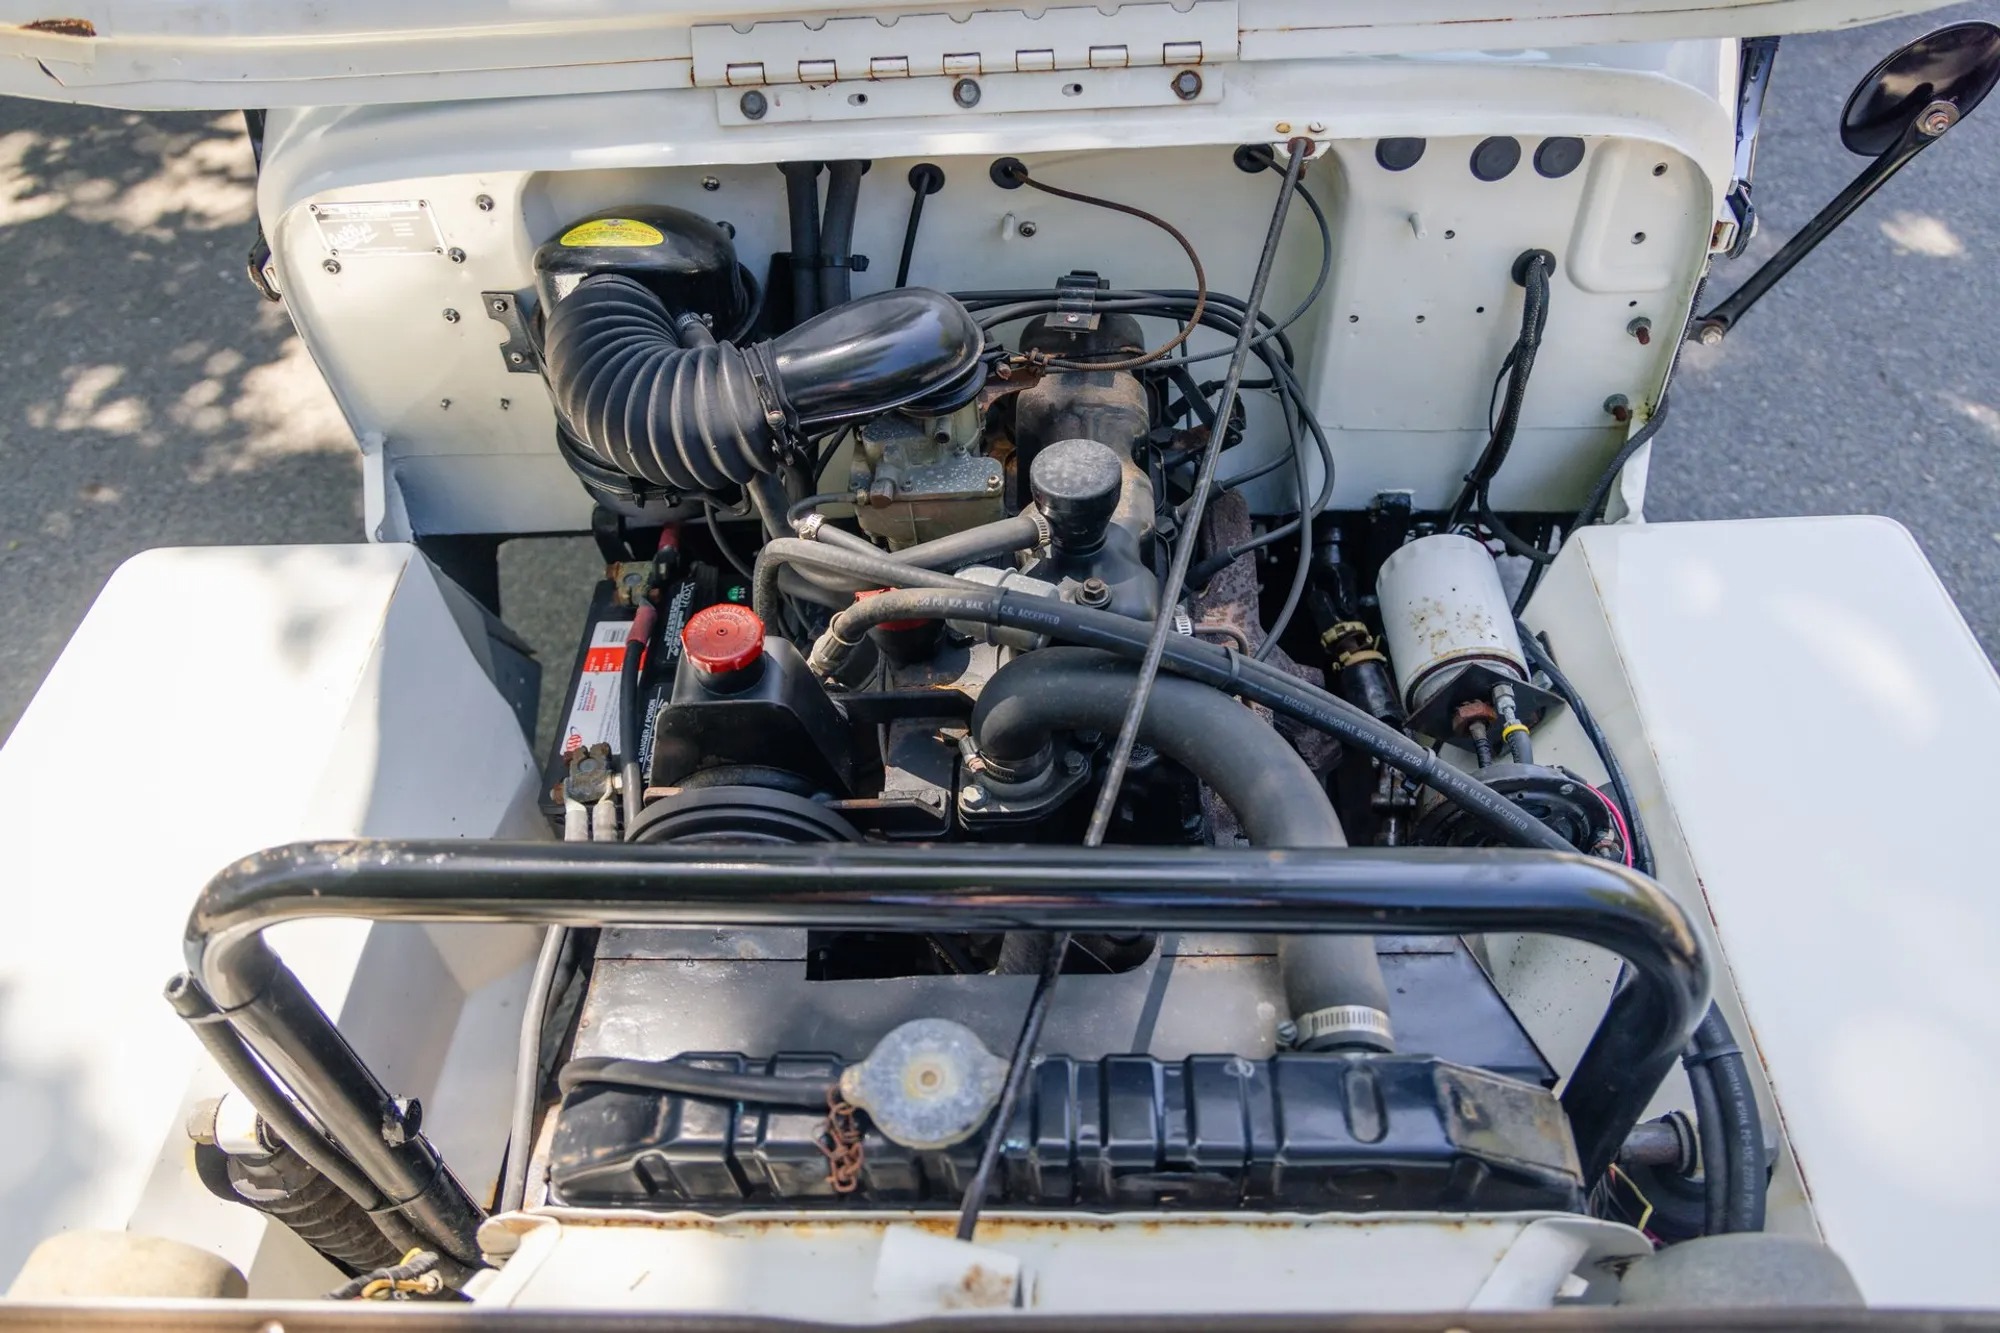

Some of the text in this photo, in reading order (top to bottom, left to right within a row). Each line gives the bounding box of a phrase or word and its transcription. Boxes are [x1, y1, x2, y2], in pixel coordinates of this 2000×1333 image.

[1018, 608, 1060, 625] ACCEPTED
[638, 728, 651, 756] DANGER
[645, 698, 657, 723] POISON
[1283, 694, 1314, 716] EXCEEDS
[1402, 751, 1423, 767] 2250
[1492, 804, 1529, 830] ACCEPTED
